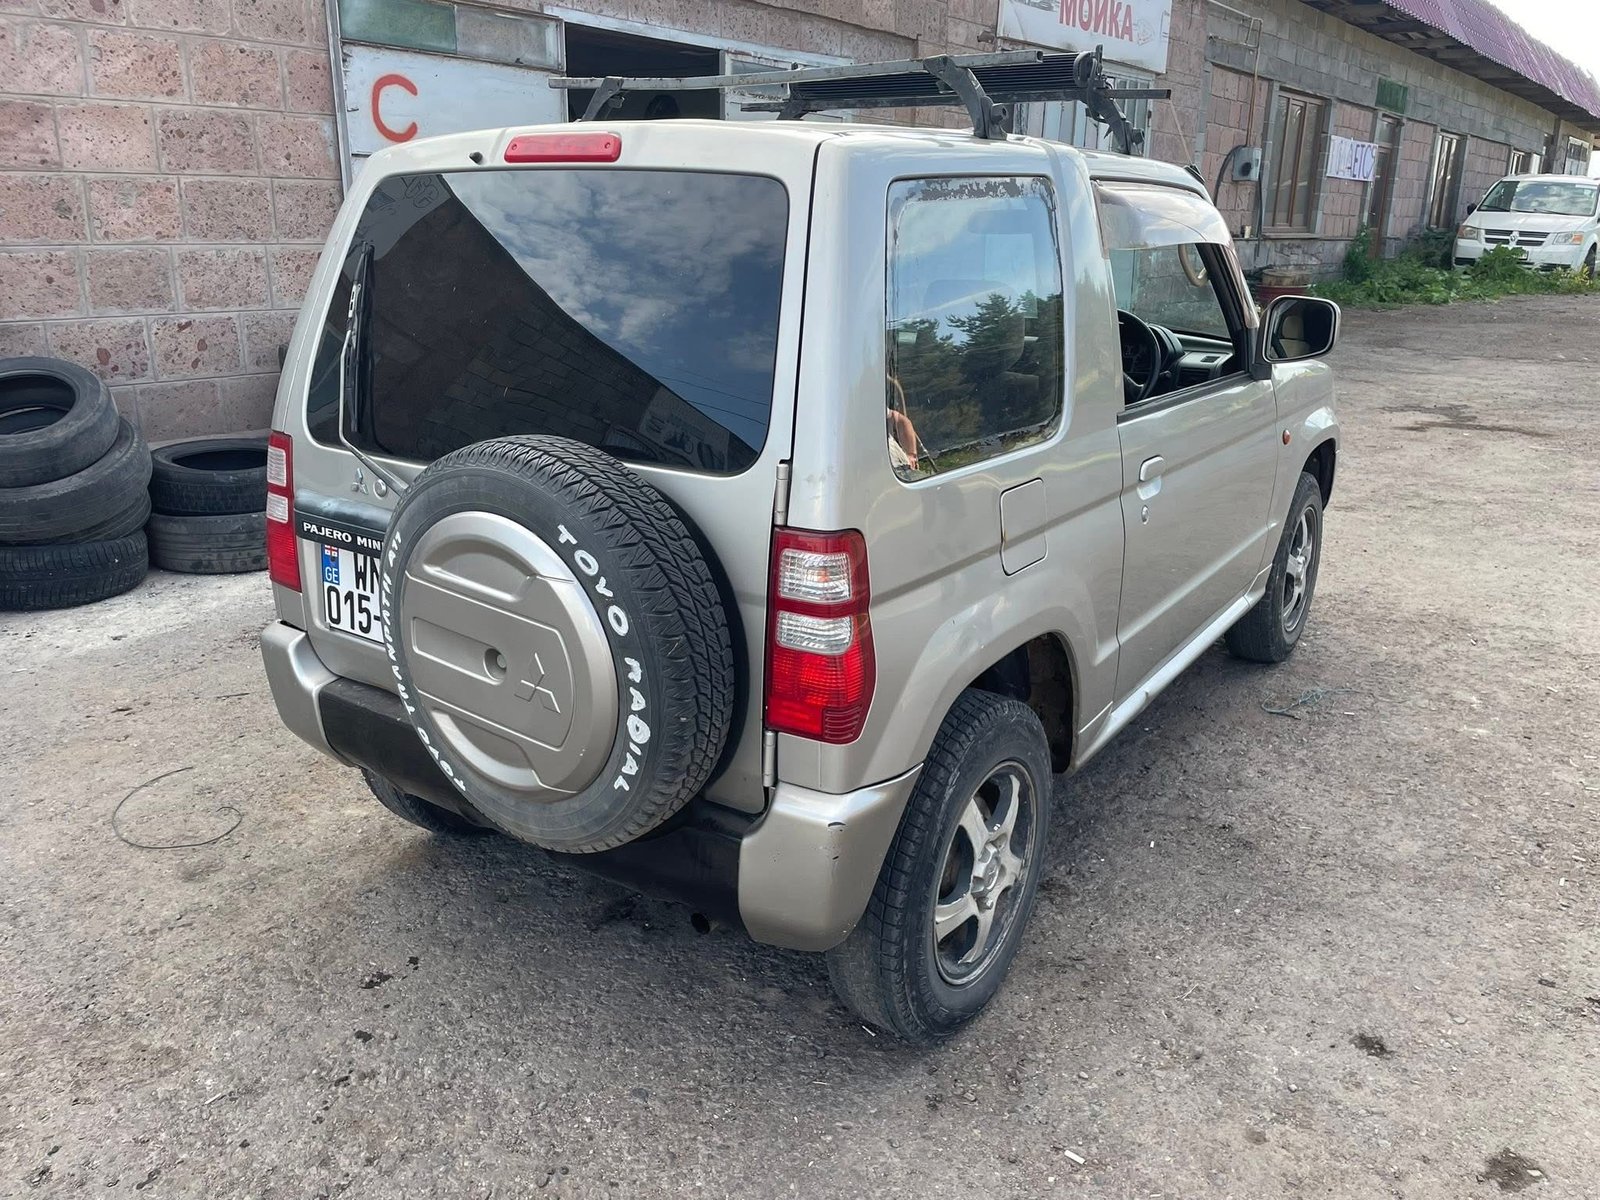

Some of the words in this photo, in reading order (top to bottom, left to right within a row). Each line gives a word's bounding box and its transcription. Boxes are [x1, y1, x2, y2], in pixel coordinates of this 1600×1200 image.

[303, 521, 352, 543] PAJERO
[325, 566, 339, 584] GE
[557, 524, 629, 637] TOYO
